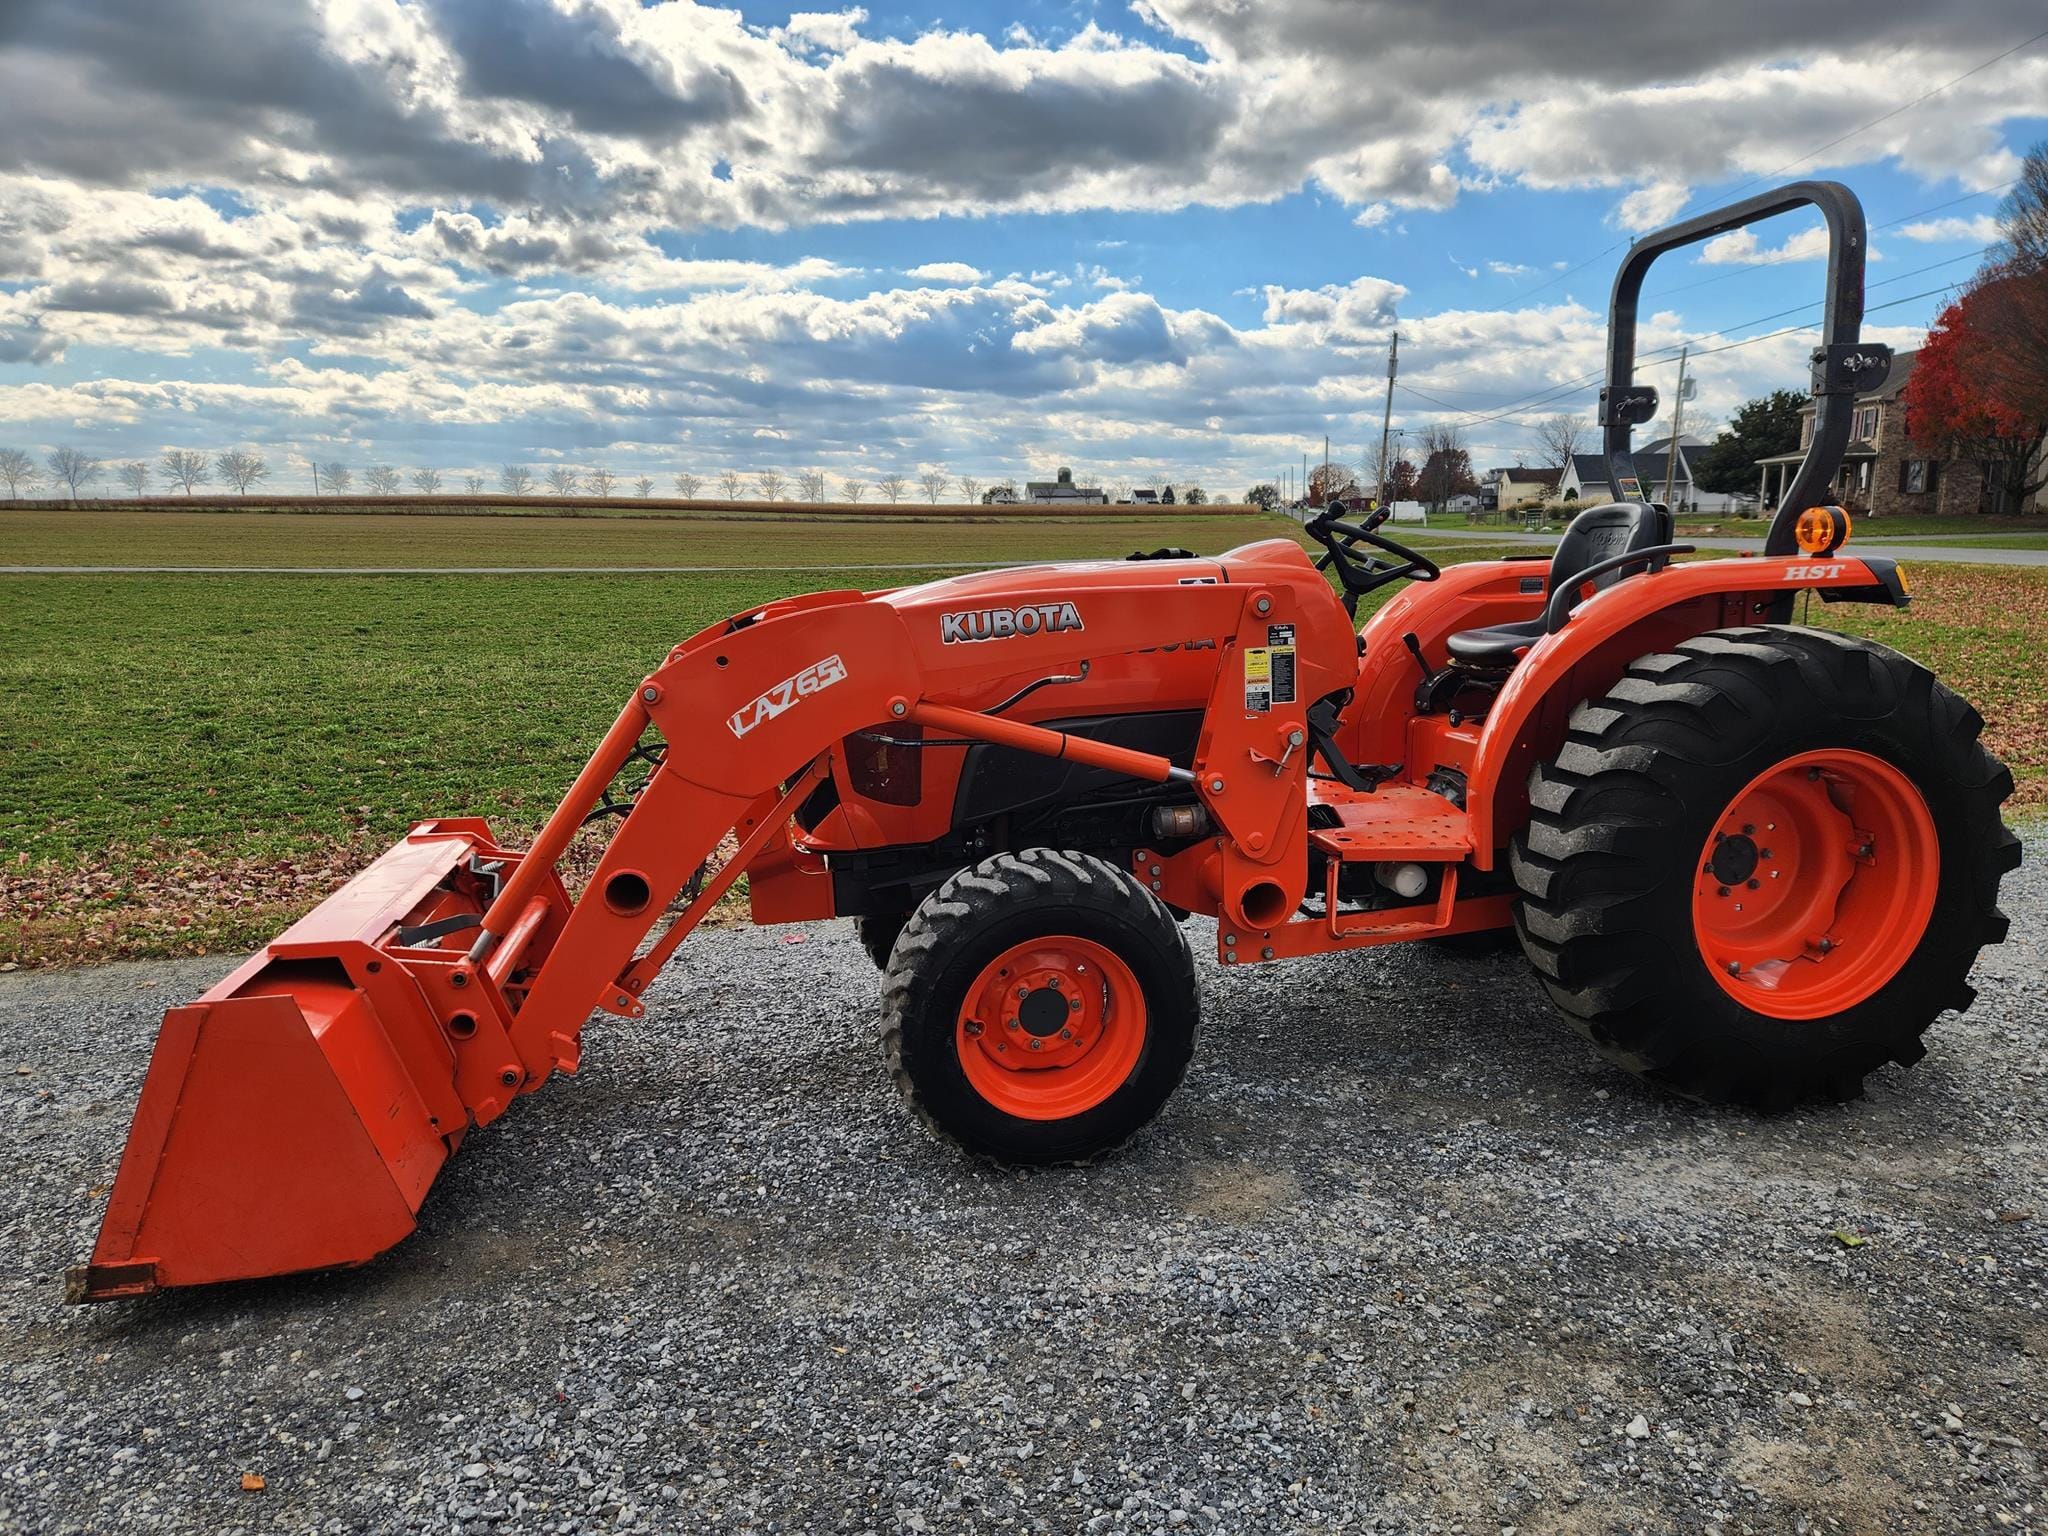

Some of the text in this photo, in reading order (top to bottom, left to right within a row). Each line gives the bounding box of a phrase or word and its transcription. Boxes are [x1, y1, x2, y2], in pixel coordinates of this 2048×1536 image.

[1783, 564, 1846, 581] HST
[941, 602, 1084, 644] KUBOTA
[731, 656, 846, 737] LA765
